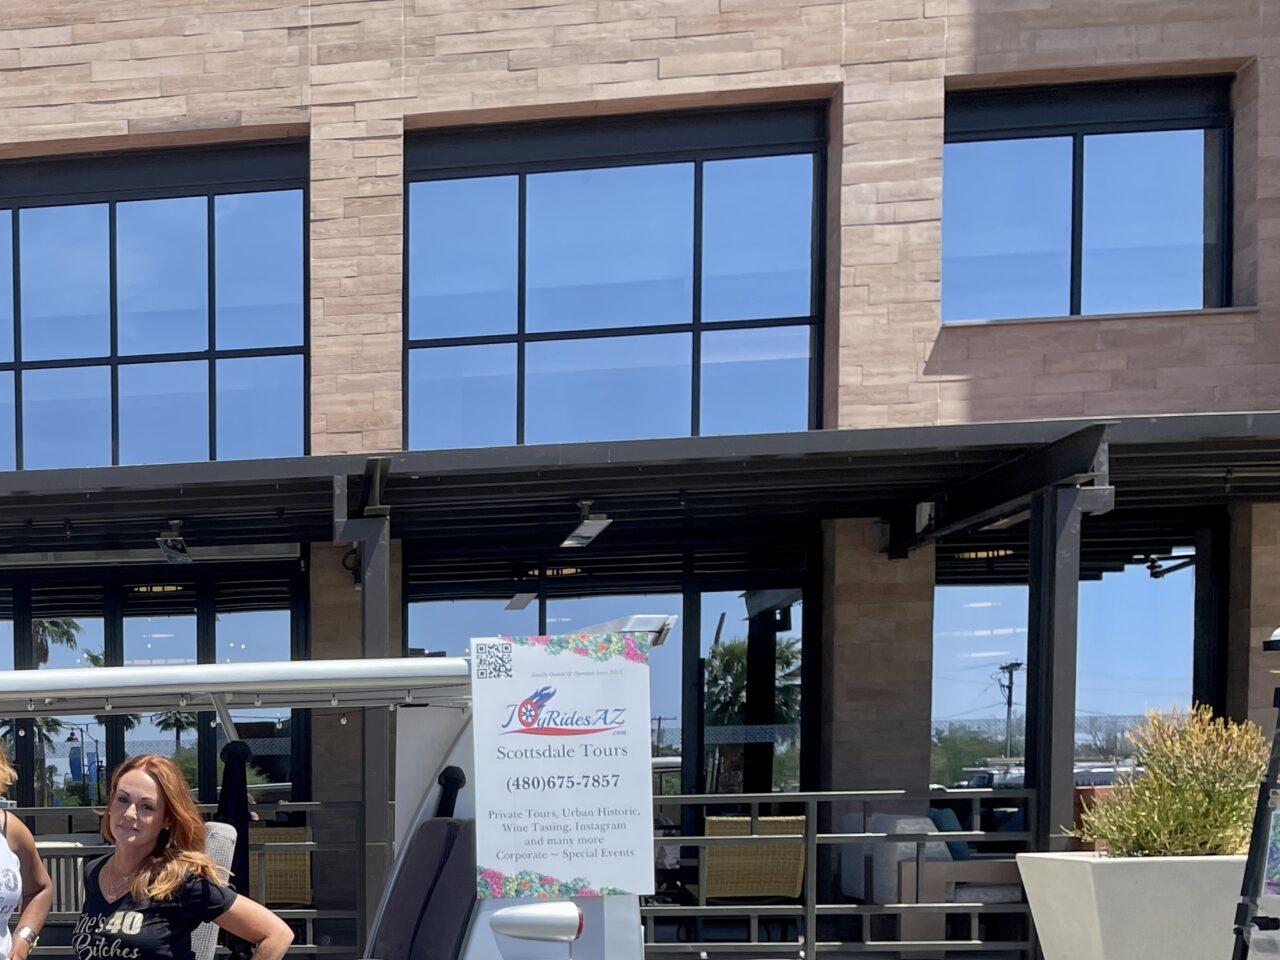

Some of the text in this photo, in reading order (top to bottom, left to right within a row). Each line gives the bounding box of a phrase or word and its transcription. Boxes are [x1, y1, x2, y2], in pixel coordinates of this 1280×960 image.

[496, 743, 629, 760] Scottsdale Tours
[506, 774, 621, 793] (480)675-7857
[488, 806, 641, 820] Private Tours, Urban Historic,
[502, 821, 627, 834] Wine Tasting, Instagram
[524, 836, 605, 848] and many more
[496, 850, 548, 862] Corporate
[562, 848, 598, 861] Special
[601, 848, 635, 858] Events
[72, 911, 144, 935] he's 40
